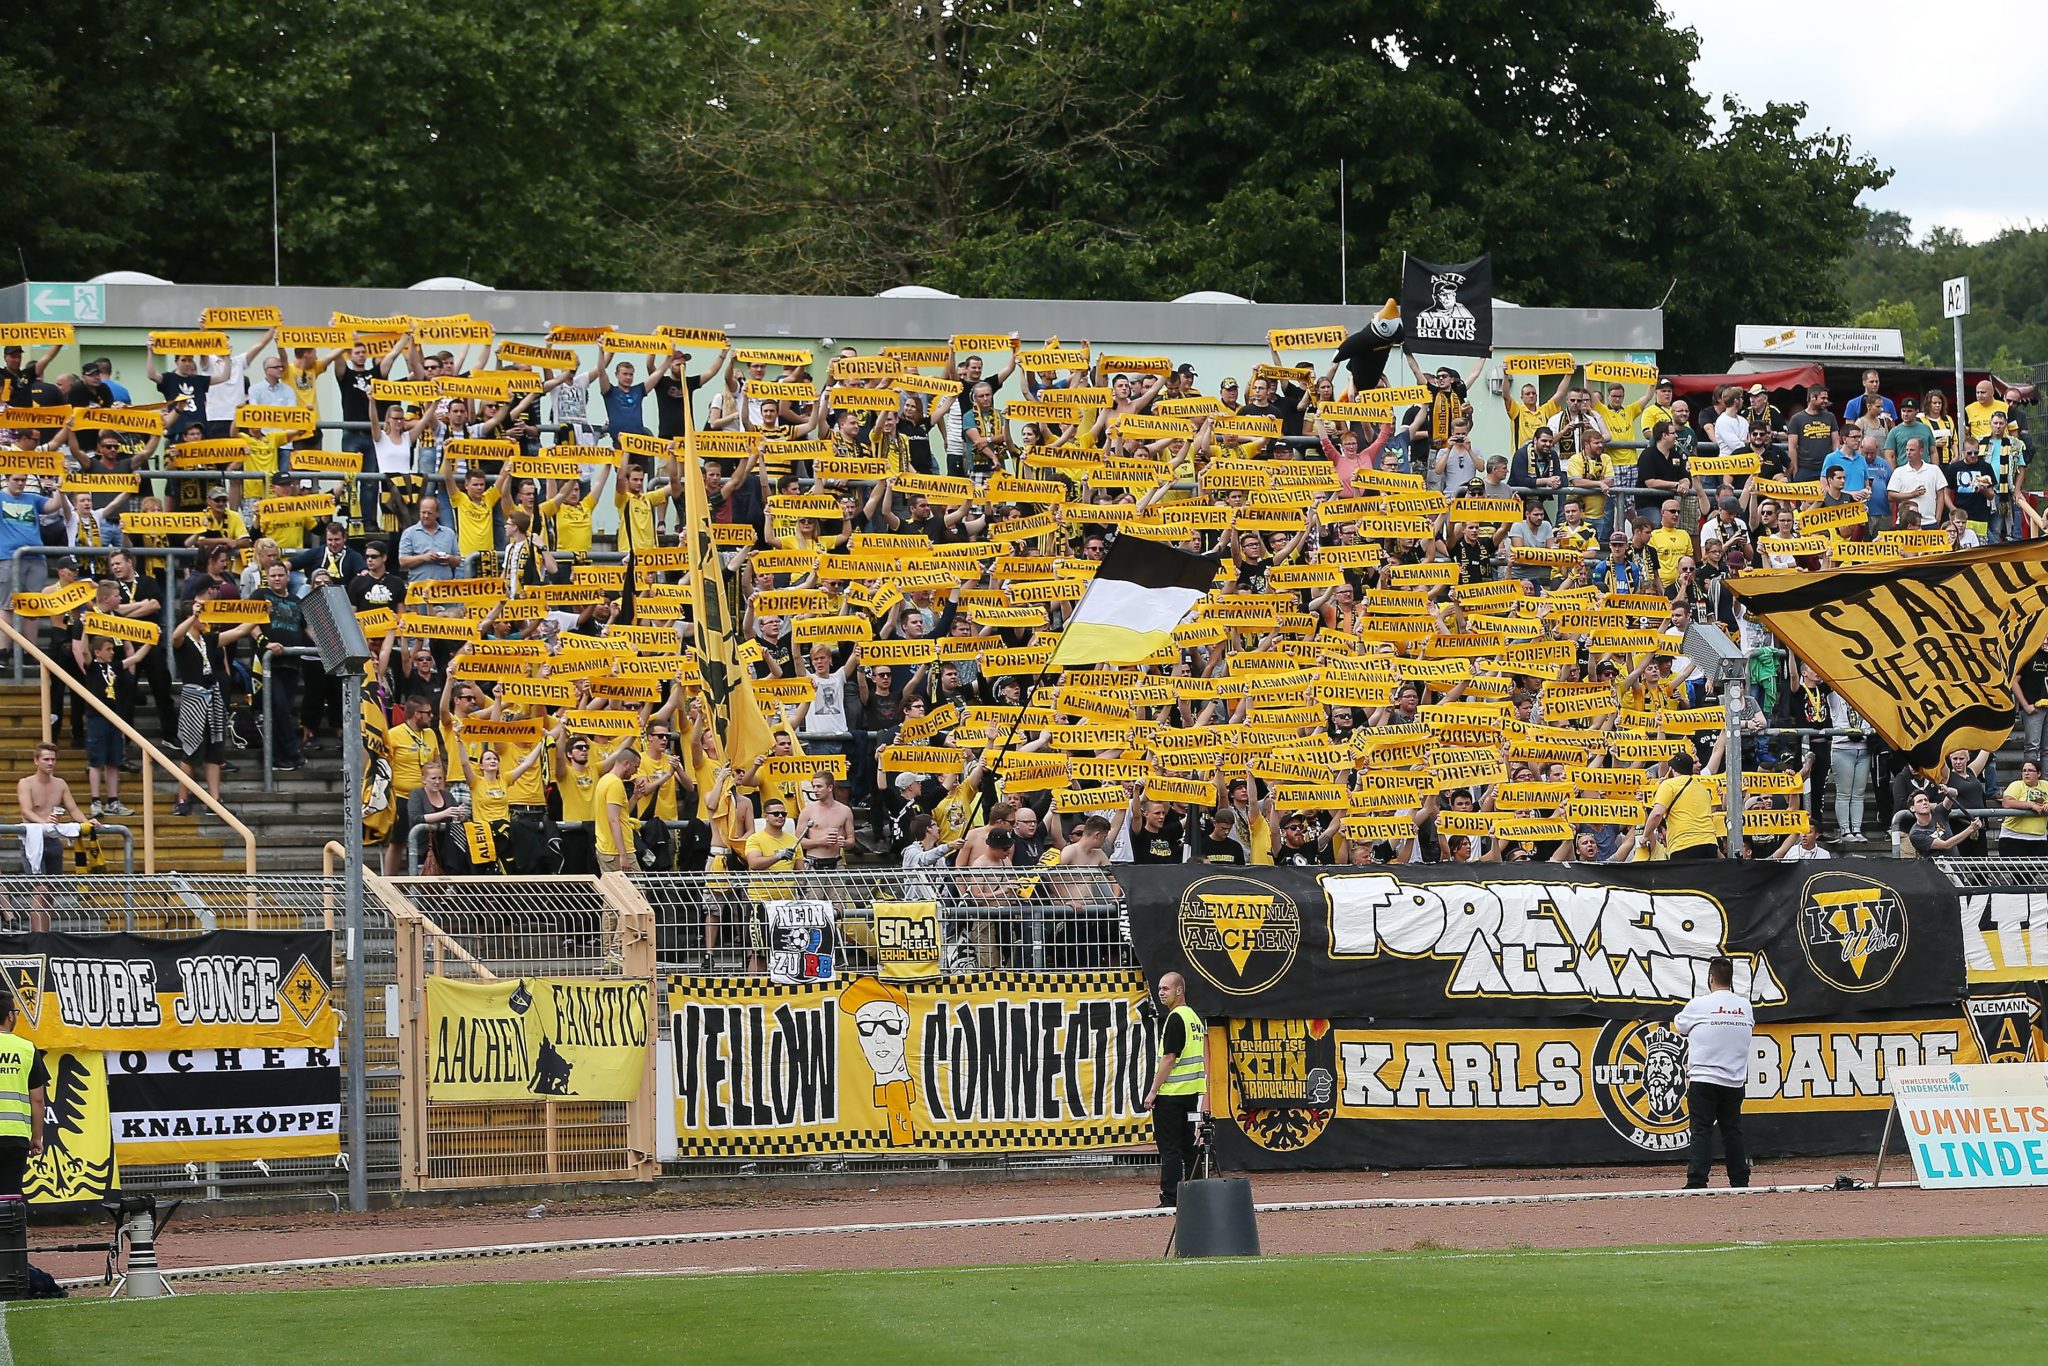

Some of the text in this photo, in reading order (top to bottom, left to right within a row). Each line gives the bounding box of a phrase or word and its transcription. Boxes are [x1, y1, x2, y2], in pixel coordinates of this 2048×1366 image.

[1431, 273, 1466, 284] ANTE
[1948, 284, 1961, 311] A2
[209, 309, 274, 322] FOREVER
[1416, 317, 1476, 331] IMMER
[282, 331, 346, 344] FOREVER
[420, 327, 489, 339] FOREVER
[662, 328, 727, 342] ALEMANNIA
[1275, 331, 1343, 347] FOREVER
[1418, 329, 1475, 341] BEI UNS
[1828, 331, 1877, 341] Spezialitäten
[154, 338, 222, 349] ALEMANNIA
[605, 338, 668, 351] ALEMANNIA
[1824, 342, 1880, 353] Holzkohlegrill
[503, 345, 573, 360] ALEMANNIA
[739, 351, 803, 363] ALEMANNIA
[1025, 353, 1082, 366] FOREVER
[1105, 359, 1170, 371] FOREVER
[1510, 358, 1571, 370] FOREVER
[838, 362, 901, 375] FOREVER
[1594, 364, 1657, 379] FOREVER
[373, 384, 438, 396] FOREVER
[751, 384, 815, 396] FOREVER
[1363, 389, 1425, 403] FOREVER
[833, 395, 895, 407] ALEMANNIA
[242, 410, 309, 423] FOREVER
[1008, 404, 1072, 418] FOREVER
[1322, 405, 1388, 418] ALEMANNIA
[83, 410, 157, 429] ALEMANNIA
[1124, 417, 1189, 433] ALEMANNIA
[1215, 420, 1278, 433] ALEMANNIA
[448, 443, 515, 457] ALEMANNIA
[764, 441, 827, 453] ALEMANNIA
[1029, 447, 1101, 462] ALEMANNIA
[294, 456, 357, 469] ALEMANNIA
[512, 461, 579, 475] FOREVER
[821, 461, 886, 474] FOREVER
[1694, 458, 1754, 470] FOREVER
[66, 474, 138, 487] ALEMANNIA
[1092, 469, 1155, 482] ALEMANNIA
[1204, 475, 1265, 487] FOREVER
[1357, 473, 1418, 489] ALEMANNIA
[997, 482, 1061, 494] ALEMANNIA
[1757, 483, 1818, 495] FOREVER
[1252, 492, 1312, 504] FOREVER
[263, 500, 332, 513] ALEMANNIA
[769, 500, 839, 510] ALEMANNIA
[1389, 498, 1445, 512] FOREVER
[1456, 500, 1522, 512] ALEMANNIA
[131, 516, 201, 527] FOREVER
[1066, 509, 1133, 521] ALEMANNIA
[1163, 511, 1227, 524] FOREVER
[1235, 509, 1301, 522] ALEMANNIA
[1802, 506, 1861, 527] FOREVER
[1124, 524, 1188, 535] ALEMANNIA
[1363, 520, 1431, 531] FOREVER
[862, 538, 927, 548] ALEMANNIA
[1763, 540, 1825, 552] FOREVER
[1317, 550, 1386, 563] FOREVER
[1516, 550, 1579, 563] FOREVER
[1838, 544, 1900, 556] FOREVER
[827, 559, 894, 572] ALEMANNIA
[1270, 572, 1335, 582] ALEMANNIA
[1391, 568, 1450, 579] ALEMANNIA
[17, 586, 87, 610] FOREVER
[1011, 585, 1081, 600] FOREVER
[1457, 585, 1517, 599] ALEMANNIA
[759, 597, 828, 611] FOREVER
[1368, 596, 1423, 608] ALEMANNIA
[1605, 600, 1667, 611] ALEMANNIA
[975, 607, 1044, 619] ALEMANNIA
[1203, 608, 1272, 619] ALEMANNIA
[1368, 620, 1434, 632] ALEMANNIA
[1471, 619, 1538, 633] ALEMANNIA
[1562, 614, 1623, 627] FOREVER
[88, 618, 152, 640] ALEMANNIA
[407, 624, 473, 636] ALEMANNIA
[795, 624, 864, 636] ALEMANNIA
[561, 637, 628, 650] FOREVER
[942, 640, 1003, 653] ALEMANNIA
[1435, 635, 1500, 647] ALEMANNIA
[1592, 634, 1655, 646] ALEMANNIA
[861, 644, 930, 658] FOREVER
[1507, 647, 1570, 661] FOREVER
[458, 663, 521, 674] ALEMANNIA
[550, 659, 609, 674] ALEMANNIA
[1232, 659, 1295, 670] ALEMANNIA
[1400, 661, 1465, 674] FOREVER
[502, 683, 569, 698] FOREVER
[1314, 686, 1383, 699] FOREVER
[1064, 696, 1130, 718] ALEMANNIA
[1546, 698, 1612, 714] FOREVER
[1253, 712, 1320, 724] ALEMANNIA
[1050, 730, 1126, 742] FOREVER
[1433, 750, 1494, 764] FOREVER
[1512, 748, 1582, 762] ALEMANNIA
[769, 761, 841, 774] FOREVER
[1071, 764, 1149, 776] FOREVER
[1257, 761, 1330, 780] ALEMANNIA
[1571, 772, 1641, 784] FOREVER
[1148, 780, 1207, 796] ALEMANNIA
[1278, 790, 1341, 801] ALEMANNIA
[1569, 804, 1637, 817] FOREVER
[1499, 825, 1564, 836] ALEMANNIA
[776, 905, 826, 927] NEIN
[1180, 900, 1300, 922] ALEMANNIA
[1320, 874, 1729, 958] FOREVER
[1805, 899, 1896, 944] KLV
[879, 918, 934, 946] 50+1
[902, 939, 937, 949] REGEL
[1185, 926, 1300, 952] AACHEN
[1841, 925, 1898, 962] Ultra
[880, 948, 938, 961] ERHALTEN!
[773, 953, 832, 978] ZU RB
[20, 969, 34, 985] A
[51, 954, 281, 1028] HURE JONGE
[433, 984, 647, 1083] AACHEN FANATICS
[1997, 1018, 2020, 1048] A
[672, 998, 839, 1129] YELLOW
[1234, 1051, 1307, 1081] KEIN
[1341, 1041, 1584, 1107] KARLS
[1902, 1083, 1969, 1093] LINDENSCHMIDT
[121, 1111, 334, 1138] KNALLKÖPPE
[1909, 1106, 2048, 1136] UMWELTS
[1918, 1140, 2048, 1179] LINDE
